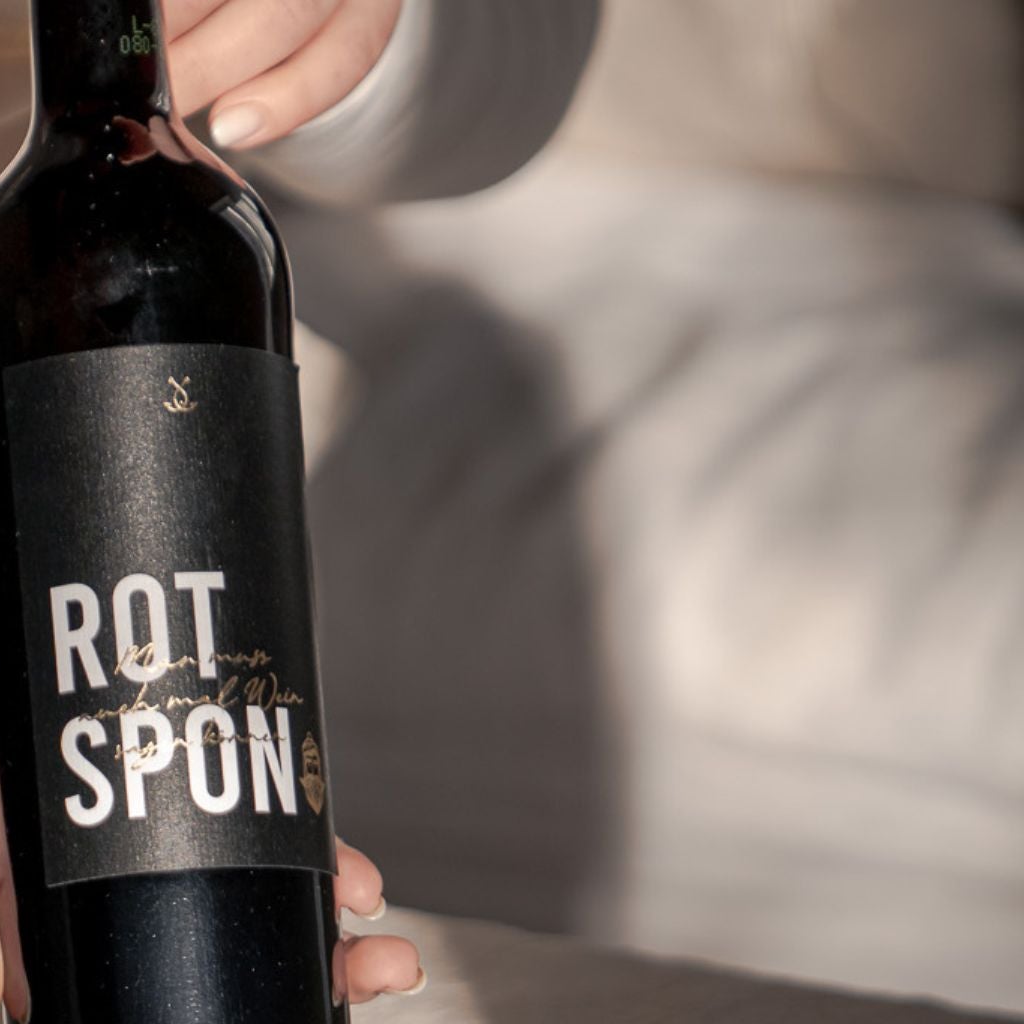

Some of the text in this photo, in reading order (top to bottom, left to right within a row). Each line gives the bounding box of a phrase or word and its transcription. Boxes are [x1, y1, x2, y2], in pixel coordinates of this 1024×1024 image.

[49, 571, 225, 695] ROT
[167, 676, 239, 709] mal
[244, 671, 304, 711] Wein
[61, 704, 297, 826] SPON
